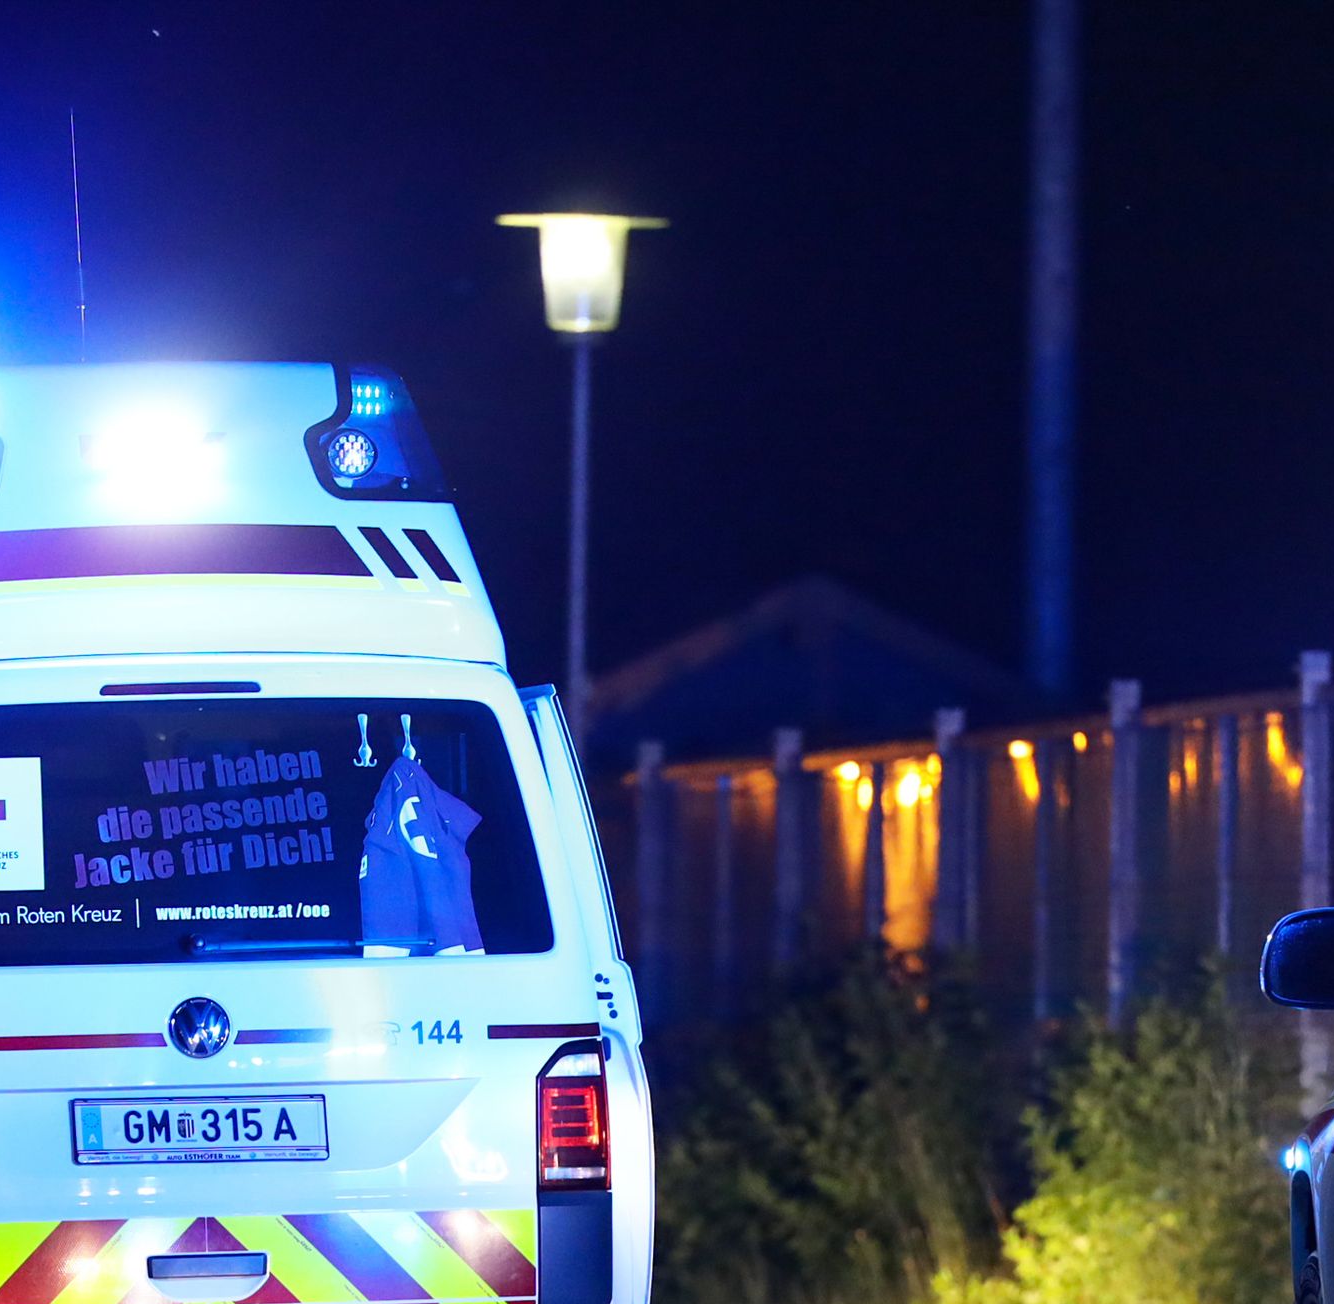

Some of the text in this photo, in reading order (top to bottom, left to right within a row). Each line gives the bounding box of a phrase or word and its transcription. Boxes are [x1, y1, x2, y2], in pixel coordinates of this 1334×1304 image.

[143, 749, 323, 795] Wir haben
[97, 787, 329, 843] die passende
[73, 826, 335, 889] Jacke für Dich!
[16, 906, 66, 924] Roten
[71, 904, 122, 922] Kreuz
[411, 1019, 463, 1045] 144
[123, 1107, 297, 1143] GM 315 A
